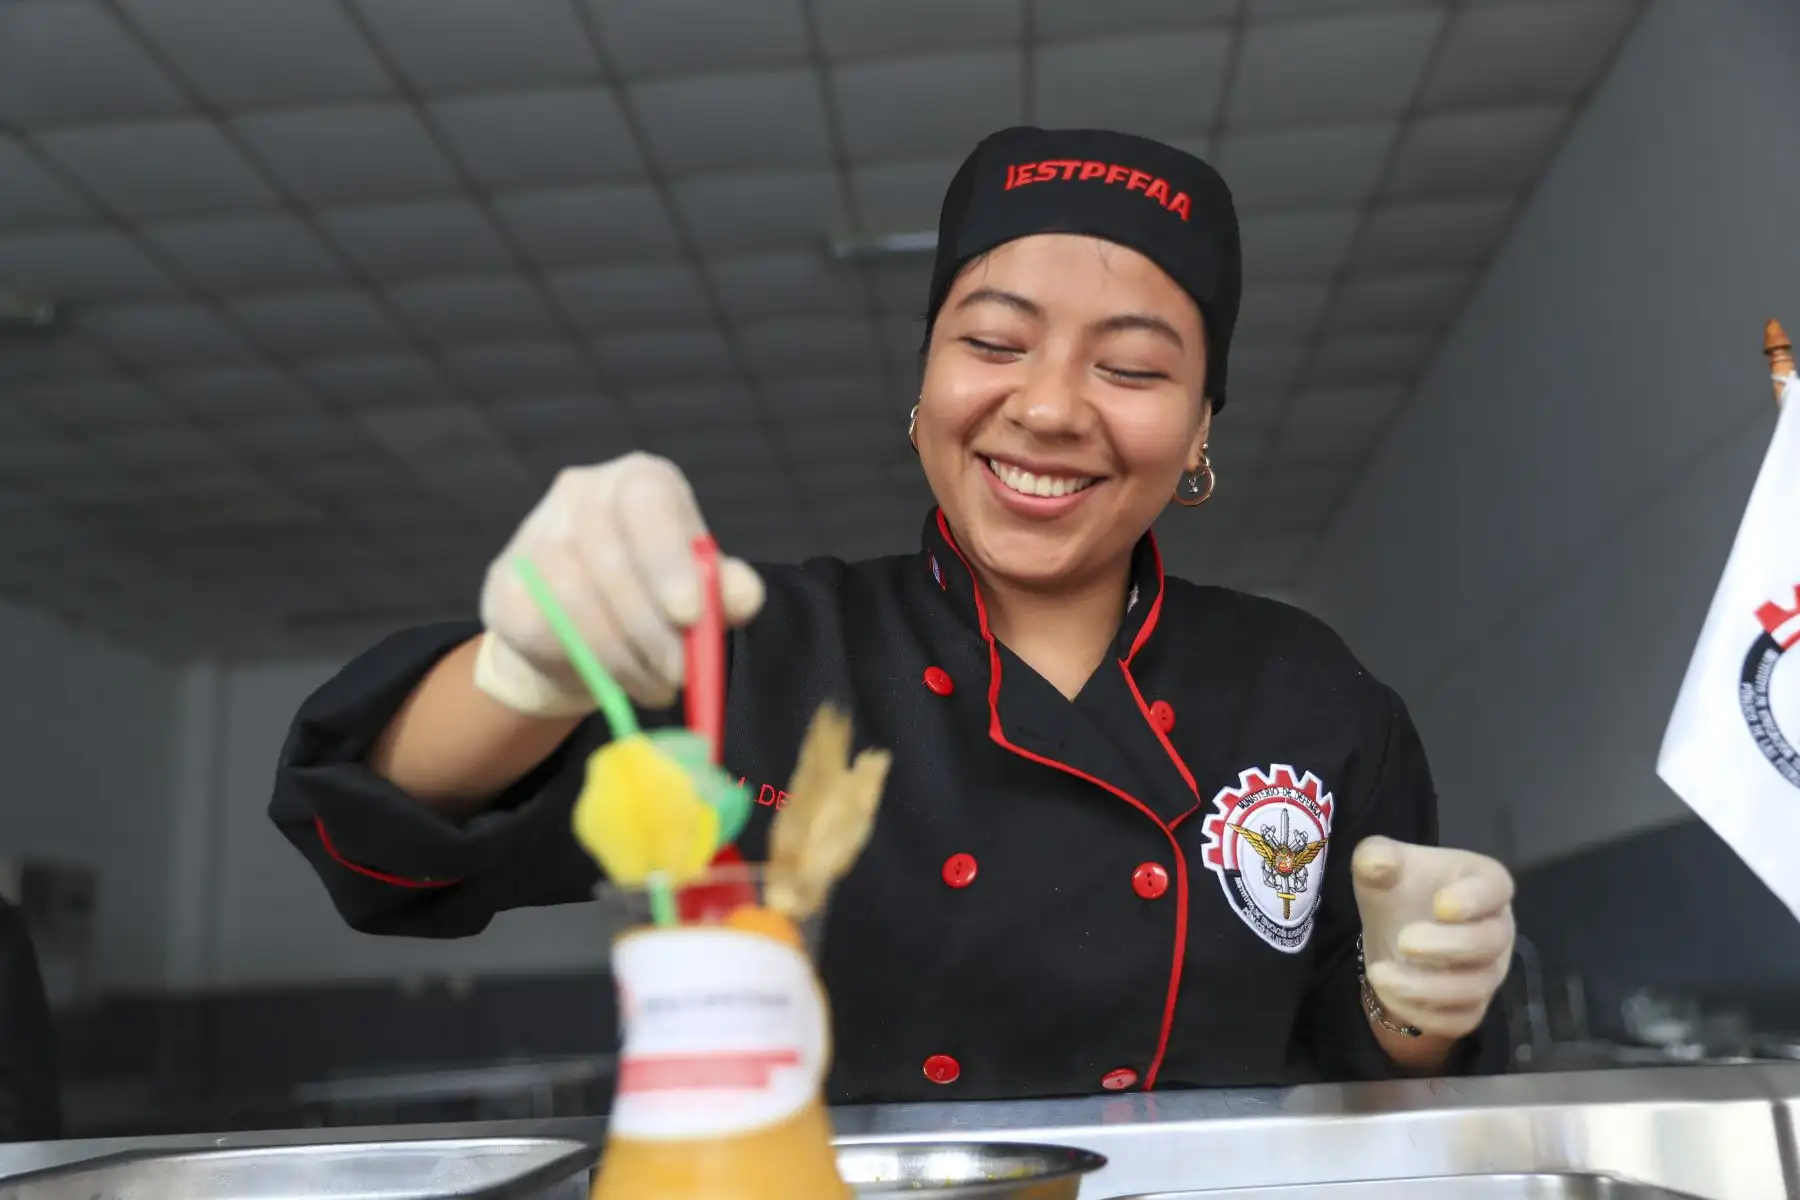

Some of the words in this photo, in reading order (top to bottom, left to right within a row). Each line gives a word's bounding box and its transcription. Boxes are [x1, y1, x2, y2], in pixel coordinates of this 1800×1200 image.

[1004, 158, 1192, 222] IESTPFFAA
[1238, 786, 1280, 809] MINISTERIO
[1282, 786, 1292, 796] DE
[1295, 791, 1321, 819] DEFENSA
